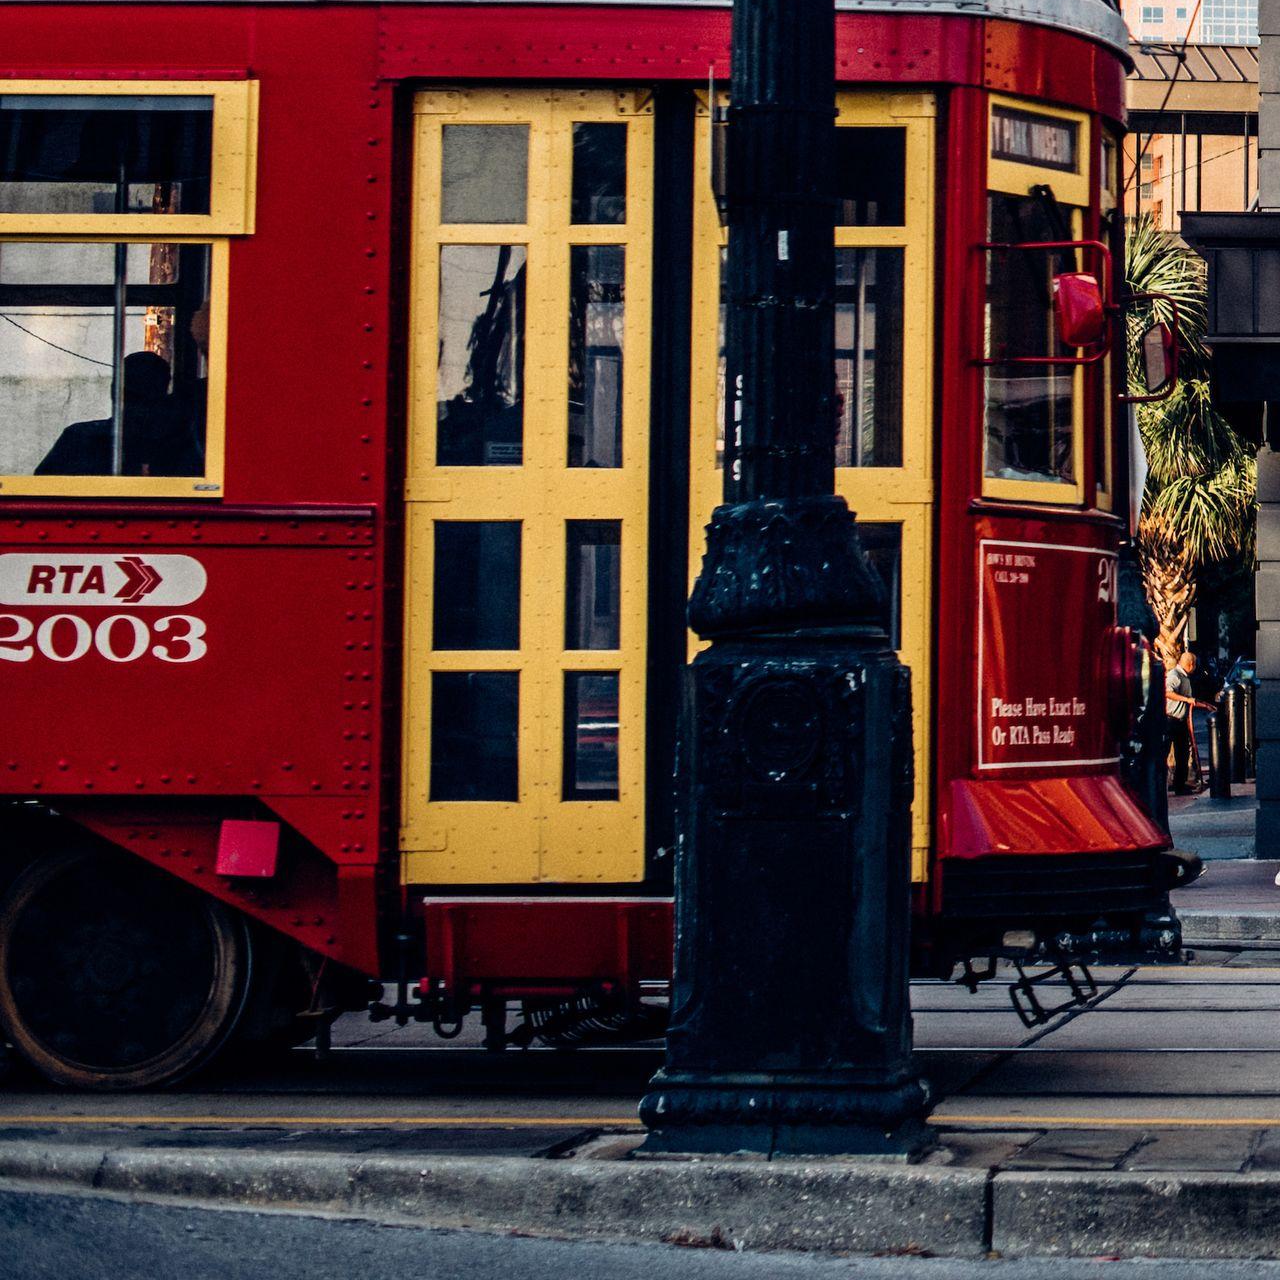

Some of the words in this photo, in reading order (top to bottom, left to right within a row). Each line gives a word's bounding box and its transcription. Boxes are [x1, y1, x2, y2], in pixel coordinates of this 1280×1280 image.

[27, 565, 105, 594] RTA
[0, 614, 207, 662] 2003
[991, 697, 1023, 717] Please
[1025, 697, 1046, 716] Have
[1049, 697, 1071, 716] Exact
[991, 726, 1007, 746] Or
[1009, 725, 1030, 745] RTA
[1032, 725, 1051, 744] Pass
[1053, 725, 1076, 747] Ready
